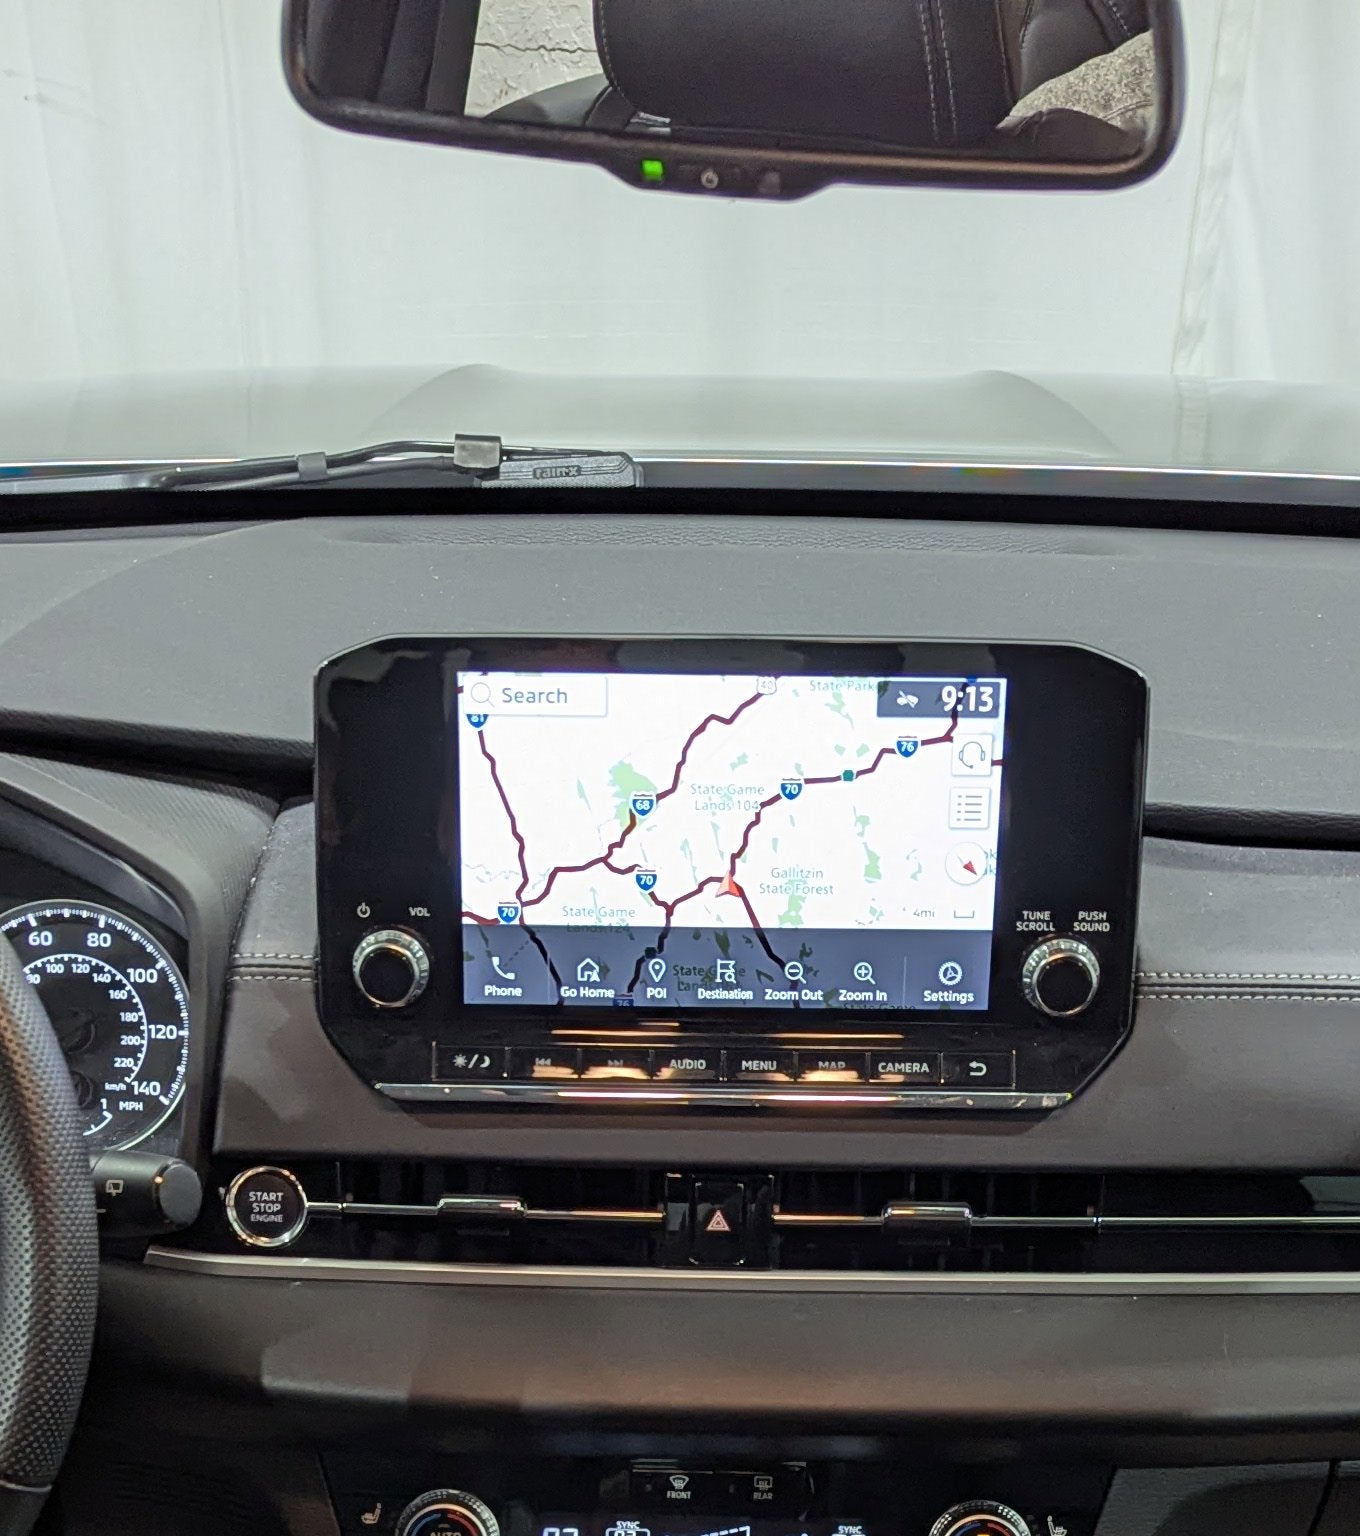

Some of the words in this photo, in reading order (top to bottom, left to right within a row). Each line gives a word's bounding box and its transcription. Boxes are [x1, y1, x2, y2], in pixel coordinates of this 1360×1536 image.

[810, 680, 842, 691] State
[502, 687, 568, 704] Search
[941, 685, 994, 712] 9:13
[901, 741, 915, 752] 76
[690, 783, 723, 795] State
[727, 783, 765, 795] Game
[784, 784, 799, 795] 70
[636, 800, 650, 811] 68
[695, 800, 732, 811] Lands
[737, 800, 759, 811] 104
[771, 867, 823, 879] Gallitzin
[640, 875, 654, 886] 70
[759, 883, 791, 895] State
[794, 883, 834, 895] Forest
[408, 907, 430, 917] VOL
[501, 907, 515, 917] 70
[562, 905, 595, 917] State
[598, 905, 636, 917] Game
[1022, 911, 1051, 920] TUNE
[1078, 911, 1107, 921] PUSH
[1016, 921, 1055, 931] SCROLL
[1073, 922, 1110, 932] SOUND
[28, 931, 53, 946] 60
[87, 933, 112, 948] 80
[45, 963, 65, 974] 100
[71, 963, 91, 974] 120
[92, 973, 112, 984] 140
[127, 968, 158, 984] 100
[108, 989, 128, 1000] 160
[484, 985, 522, 997] Phone
[560, 986, 577, 998] Go
[579, 986, 615, 998] Home
[646, 987, 667, 999] POI
[697, 987, 754, 1000] Destination
[765, 990, 798, 1001] Zoom
[801, 989, 824, 1001] Out
[839, 990, 873, 1001] Zoom
[876, 990, 888, 1001] In
[923, 990, 974, 1004] Settings
[120, 1012, 138, 1022] 180
[148, 1024, 178, 1040] 120
[120, 1035, 141, 1046] 200
[113, 1057, 135, 1068] 220
[670, 1058, 706, 1070] AUDIO
[742, 1060, 777, 1071] MENU
[818, 1060, 846, 1071] MAP
[878, 1062, 930, 1073] CAMERA
[104, 1082, 127, 1091] km/h
[131, 1080, 161, 1096] 140
[119, 1101, 144, 1111] MPH
[249, 1191, 284, 1202] START
[252, 1203, 281, 1213] STOP
[250, 1214, 284, 1223] ENGINE
[667, 1490, 691, 1500] FRONT
[753, 1492, 773, 1500] REAR
[616, 1521, 640, 1530] SYNC
[838, 1525, 862, 1534] SYNC
